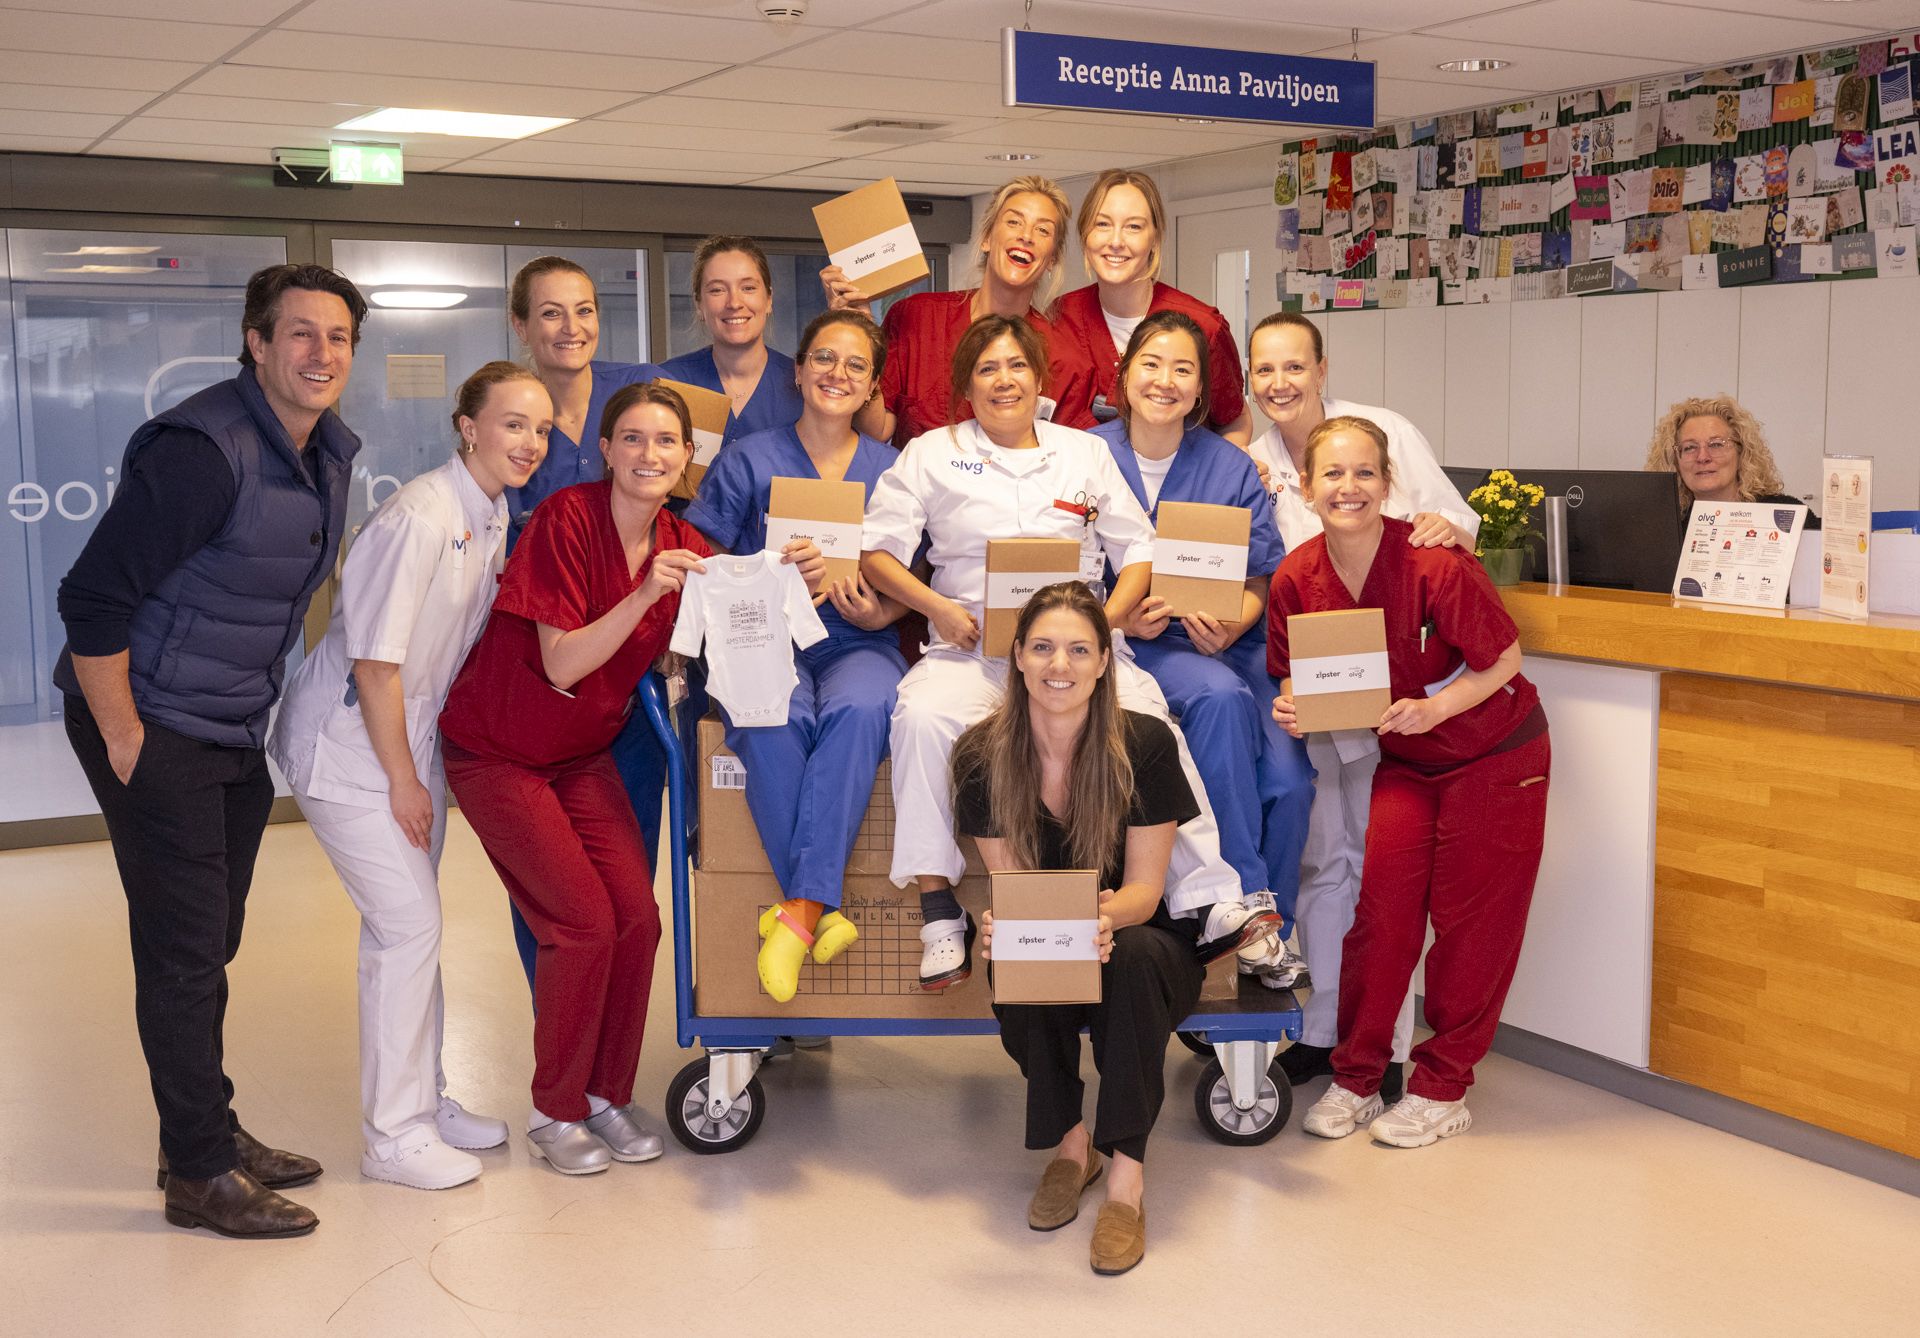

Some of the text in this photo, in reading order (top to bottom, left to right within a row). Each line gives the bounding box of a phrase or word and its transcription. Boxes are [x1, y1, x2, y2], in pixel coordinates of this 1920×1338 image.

[1058, 56, 1340, 107] Receptie Anna Paviljoen
[1778, 93, 1809, 110] Jet
[1877, 131, 1917, 161] LEA
[1500, 197, 1522, 211] Julia
[855, 251, 876, 265] zipster
[1723, 256, 1765, 274] BONNIE
[951, 459, 984, 475] olvg
[1697, 513, 1716, 526] olvg
[1176, 554, 1201, 563] zipster
[1010, 585, 1035, 594] zipster
[1315, 670, 1341, 680] zipster
[853, 912, 860, 920] M
[870, 912, 876, 920] L
[885, 912, 895, 920] XL
[1018, 935, 1046, 945] zipster
